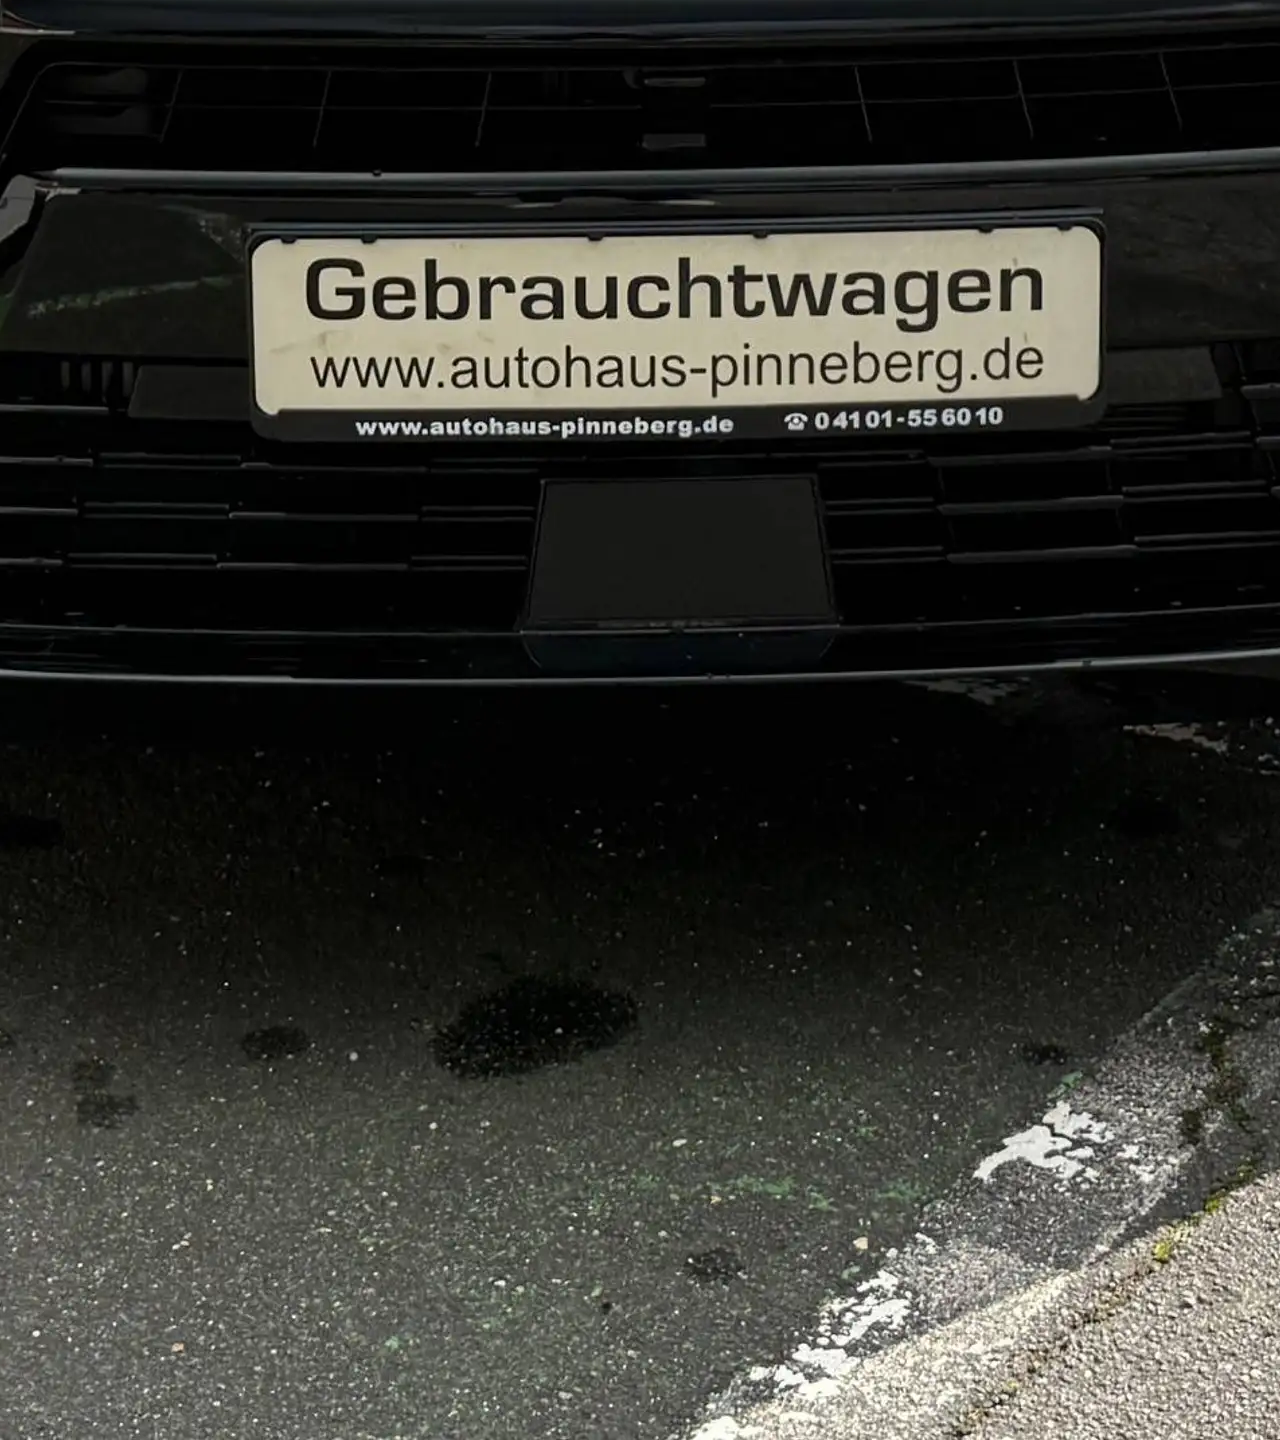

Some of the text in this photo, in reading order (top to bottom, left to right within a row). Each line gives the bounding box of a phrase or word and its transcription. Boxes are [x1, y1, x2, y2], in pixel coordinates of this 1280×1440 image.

[305, 257, 1043, 333] Gebrauchtwagen
[309, 336, 1044, 397] www.autohaus-pinneberg.de
[355, 414, 734, 439] www.autohaus-pinneberg.de
